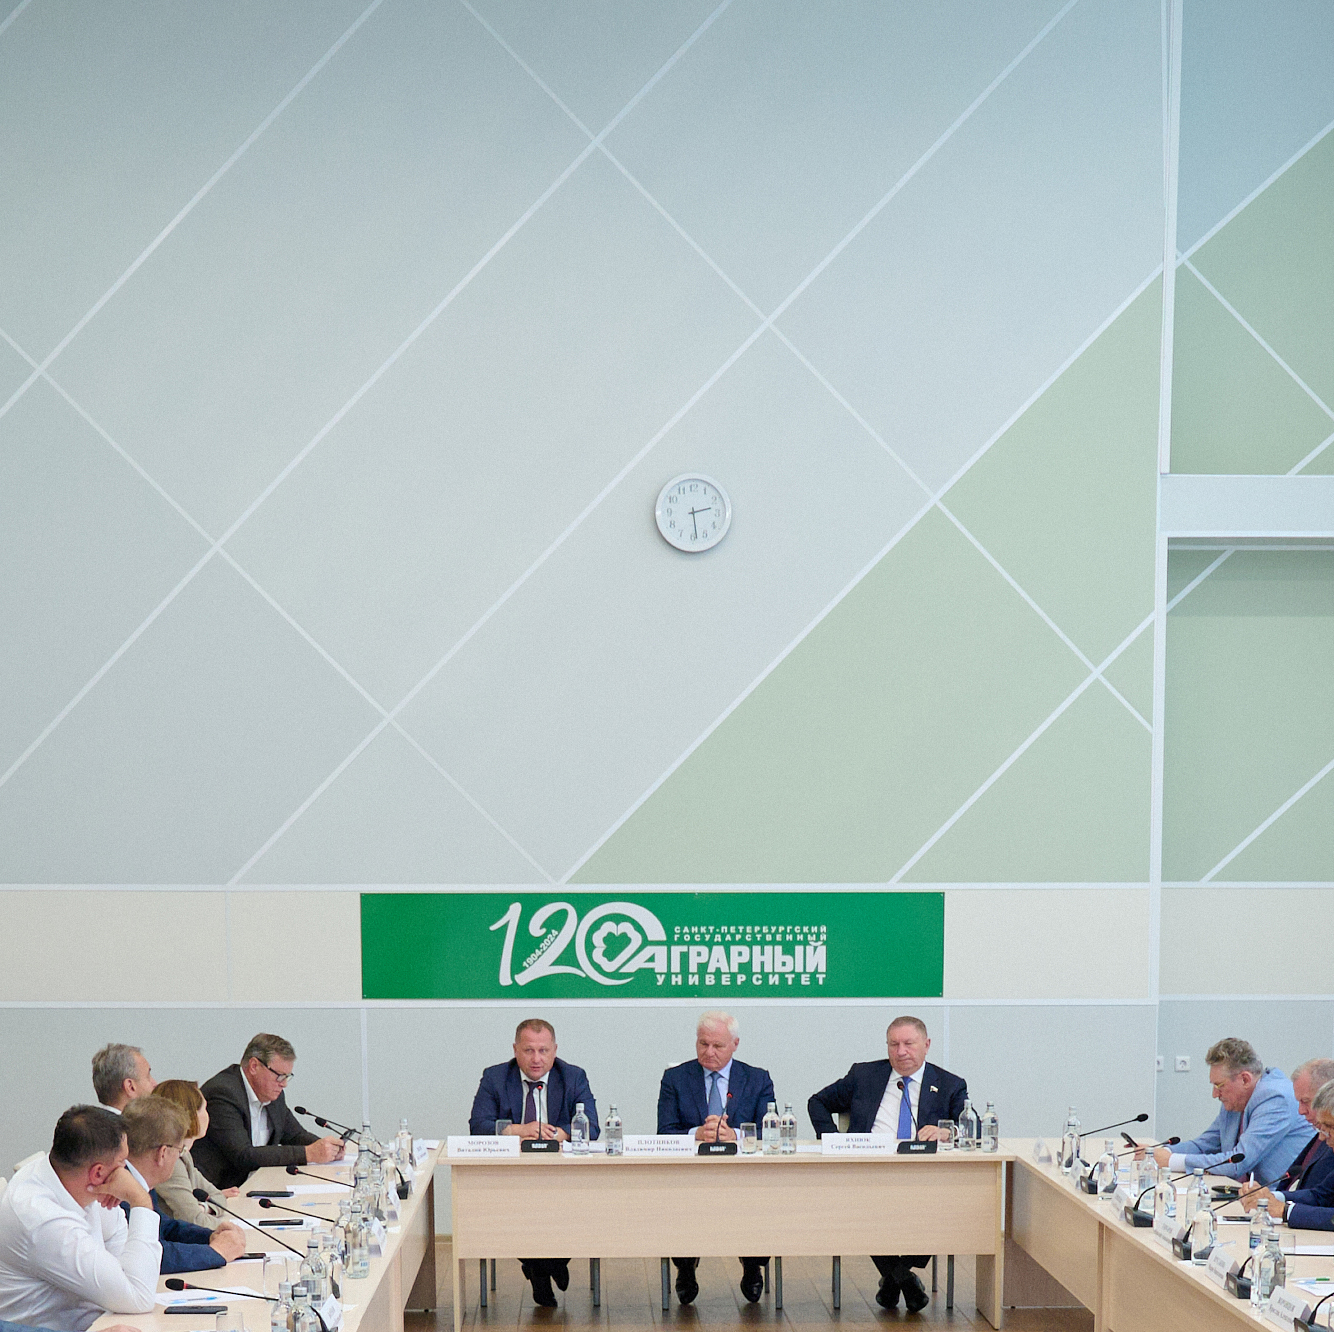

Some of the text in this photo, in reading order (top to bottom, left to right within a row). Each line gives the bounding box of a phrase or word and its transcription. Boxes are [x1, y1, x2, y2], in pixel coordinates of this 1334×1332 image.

[674, 925, 827, 933] САНКТ-ПЕТЕРБУРГСКИЙ
[674, 934, 827, 942] ГОСУДАРСТВЕННЫЙ
[522, 929, 559, 968] 1904-2024
[618, 941, 827, 973] АГРАРНЫЙ
[656, 974, 827, 986] УНИВЕРСИТЕТ
